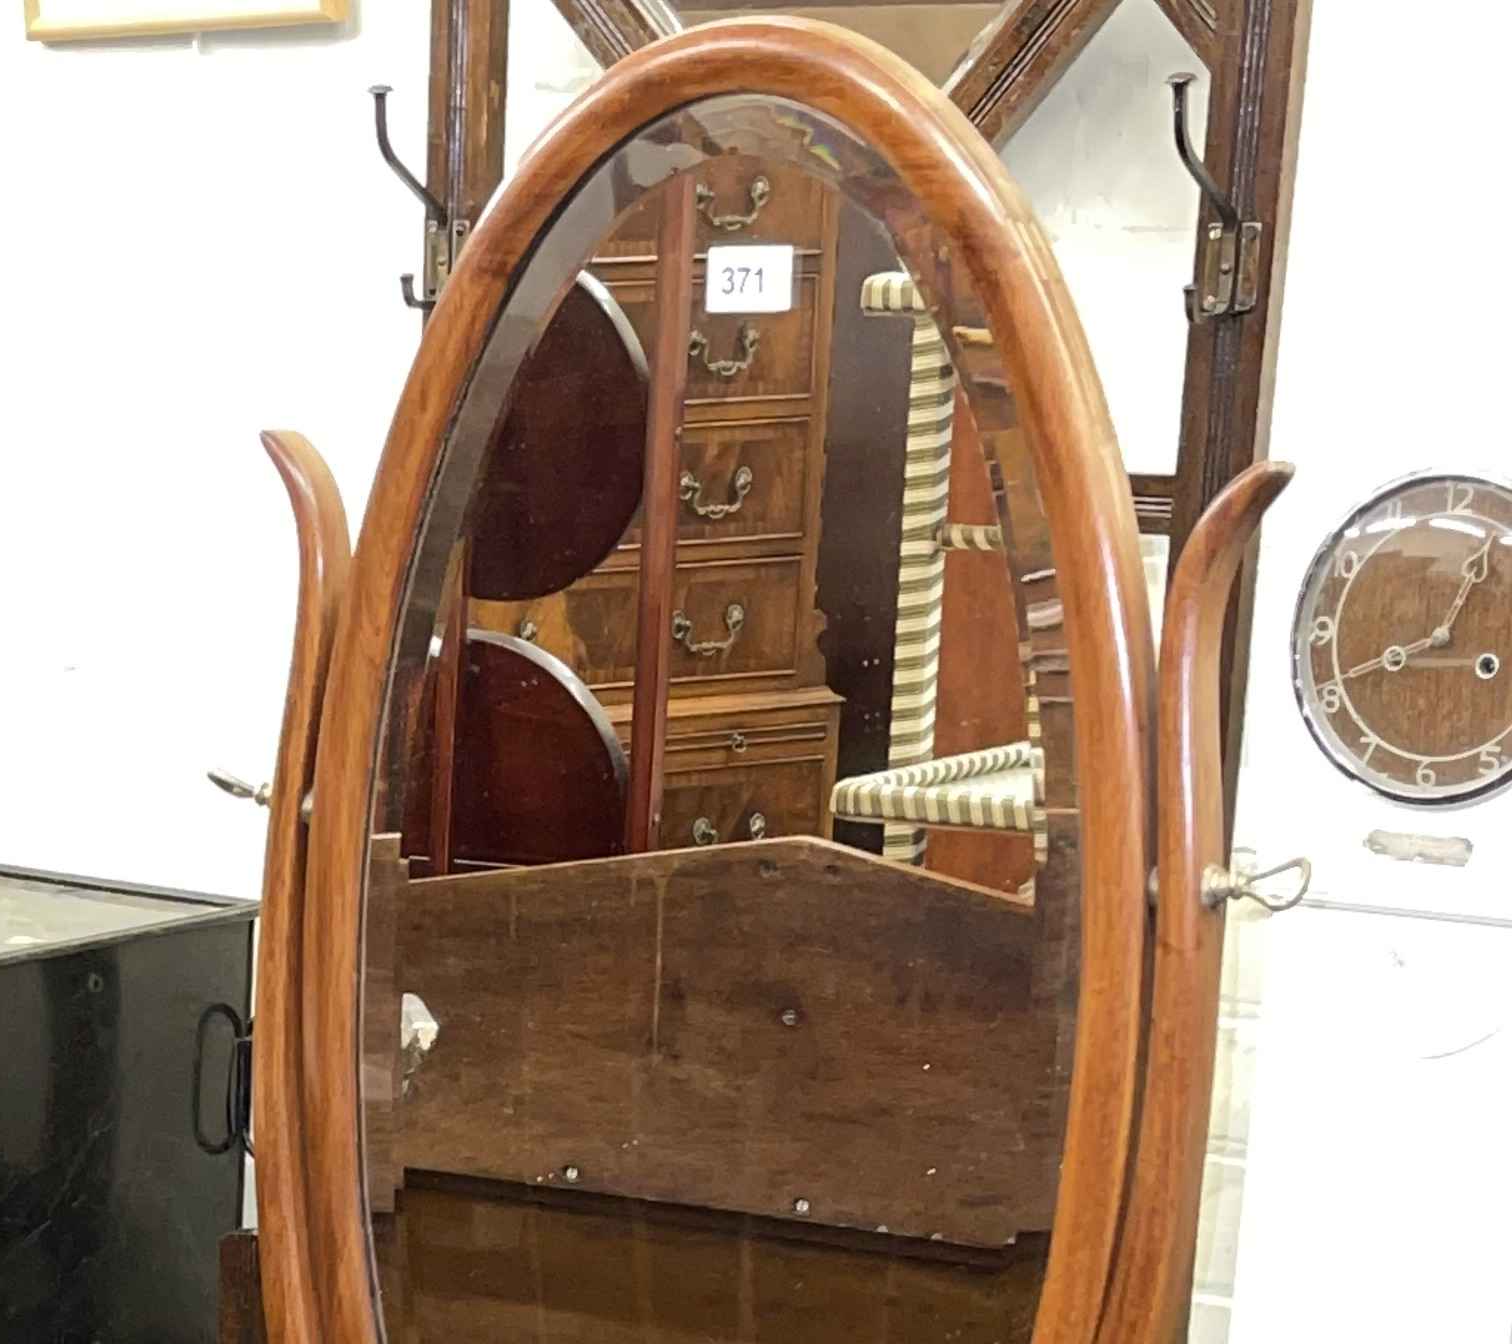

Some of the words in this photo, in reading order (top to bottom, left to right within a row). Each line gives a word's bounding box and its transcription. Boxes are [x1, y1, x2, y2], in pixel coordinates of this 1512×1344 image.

[721, 267, 764, 295] 371
[1445, 481, 1474, 514] 12
[1334, 551, 1359, 578] 10
[1309, 616, 1334, 645] 9
[1320, 686, 1341, 713] 8
[1360, 737, 1378, 766] 7
[1478, 746, 1502, 775] 5
[1416, 759, 1436, 788] 6
